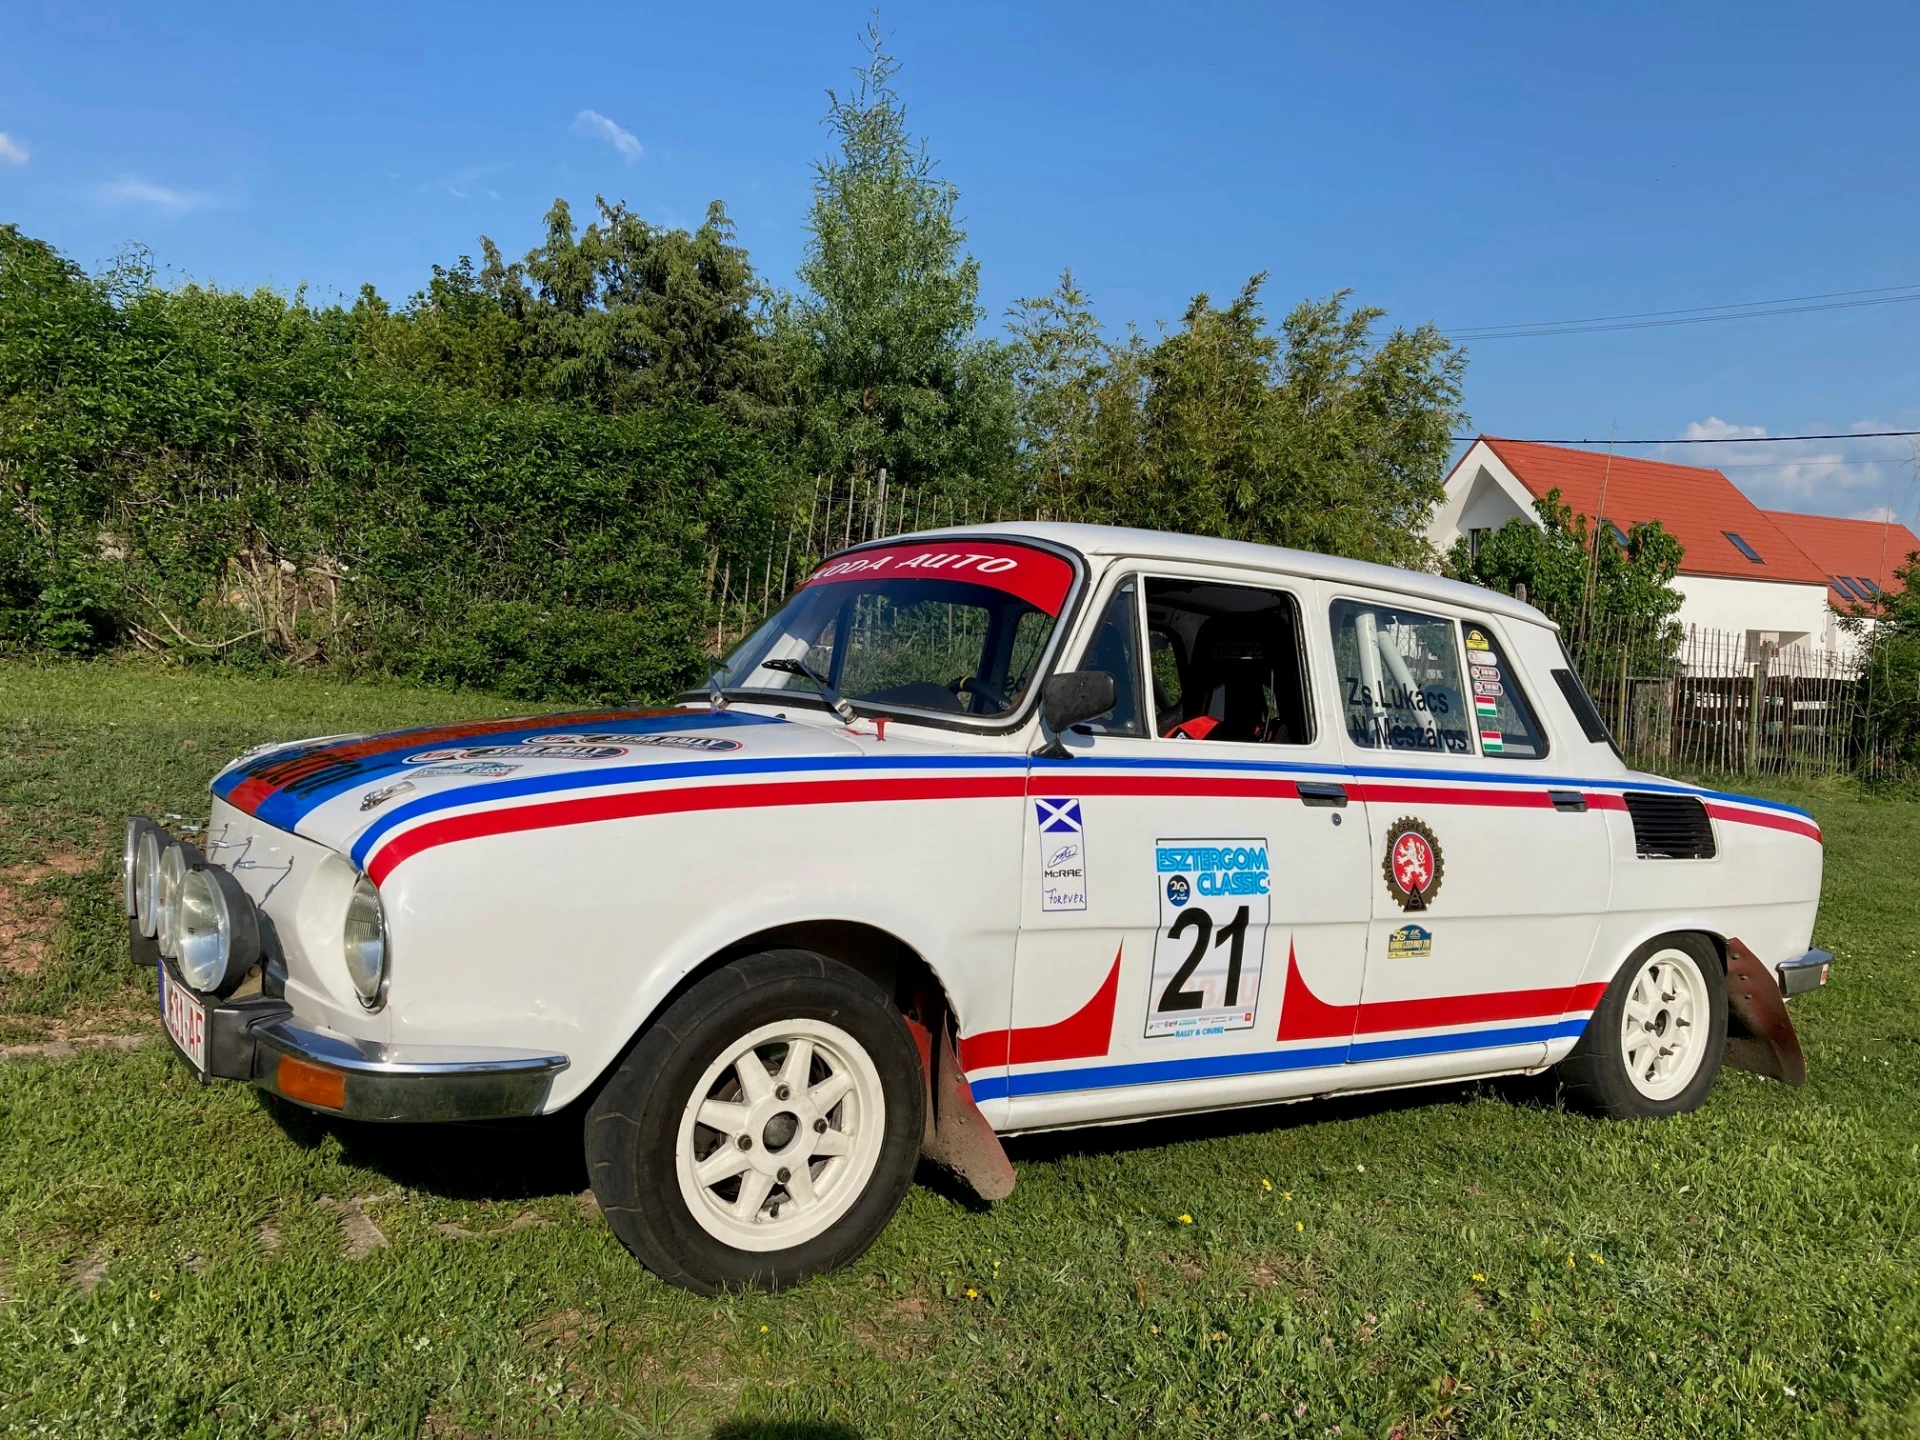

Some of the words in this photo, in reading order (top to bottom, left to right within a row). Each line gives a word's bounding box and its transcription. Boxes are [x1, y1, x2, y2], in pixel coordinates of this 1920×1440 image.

[803, 556, 894, 583] KODA
[894, 553, 1018, 573] AUTO
[1346, 677, 1449, 714] Zs.Lukács
[1156, 847, 1269, 872] ESZTERGOM
[1044, 869, 1082, 878] McRAE
[1197, 872, 1270, 896] CLASSIC
[1157, 906, 1249, 1012] 21
[1175, 1029, 1195, 1038] RALLY
